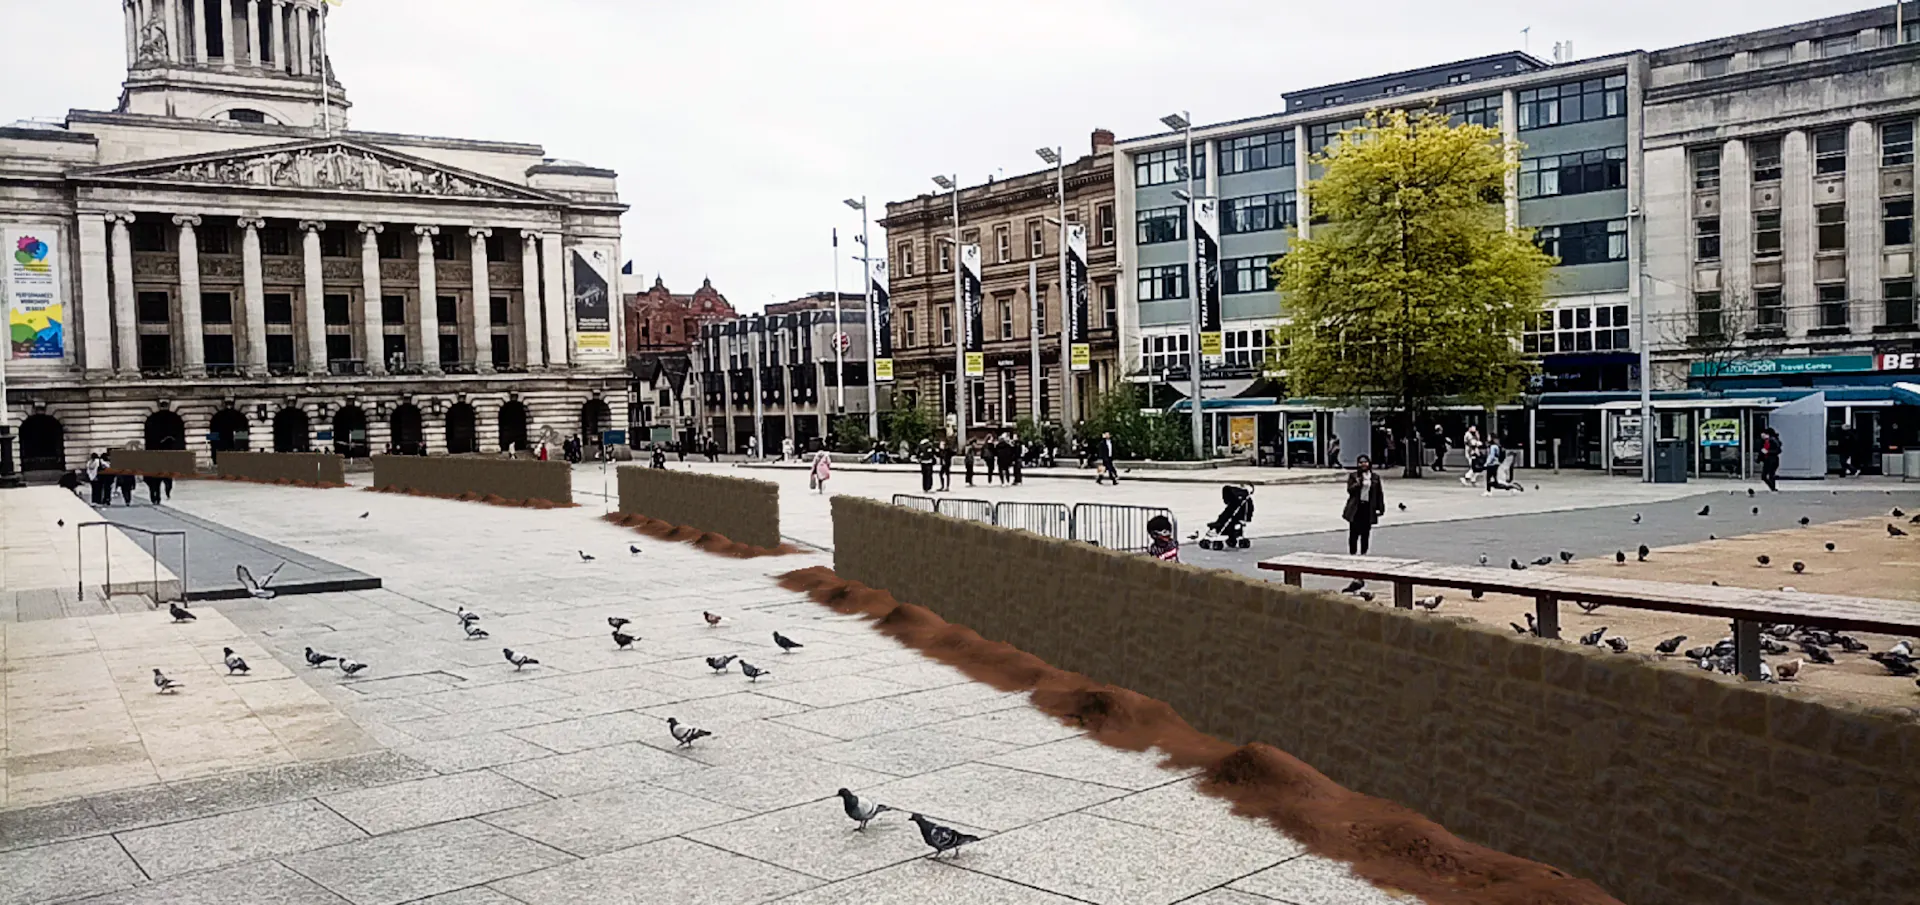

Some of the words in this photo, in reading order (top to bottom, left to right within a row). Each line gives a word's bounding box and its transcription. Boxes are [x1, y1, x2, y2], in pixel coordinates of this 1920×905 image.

[1198, 237, 1206, 255] REX
[1198, 257, 1208, 328] TYRANNOSAURUS
[1780, 363, 1804, 371] Travel
[1805, 362, 1833, 370] Centre
